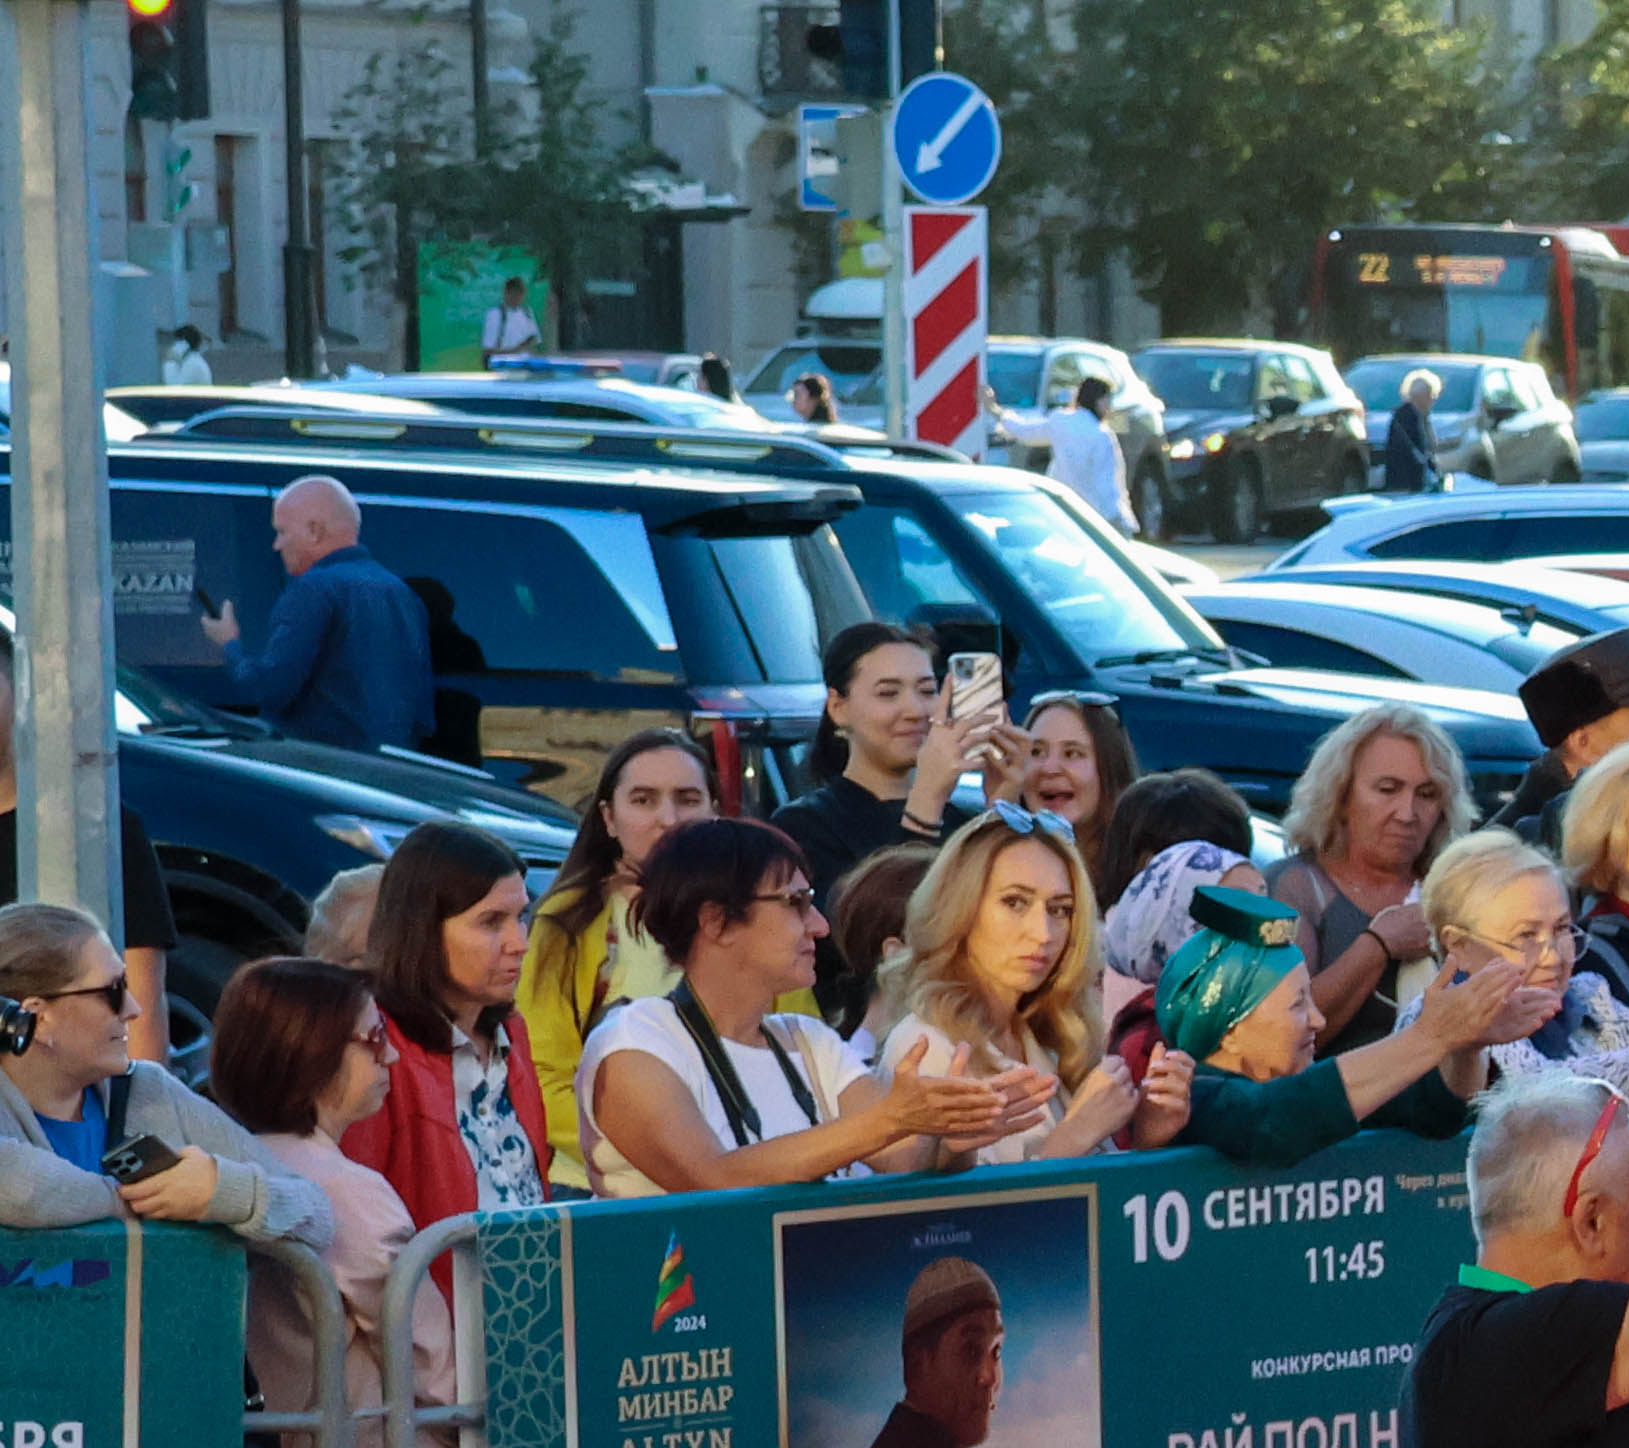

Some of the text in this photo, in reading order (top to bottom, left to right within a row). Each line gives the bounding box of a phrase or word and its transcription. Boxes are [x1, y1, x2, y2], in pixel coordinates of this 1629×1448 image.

[1359, 252, 1390, 283] 22
[1122, 1175, 1385, 1263] 10 СЕНТЯБРЯ
[1304, 1240, 1386, 1284] 11:45
[674, 1315, 707, 1333] 2024
[617, 1347, 733, 1389] АЛТЫН
[1251, 1343, 1414, 1380] КОНКУРСНАЯ ПРО
[618, 1385, 734, 1422] МИНБАР
